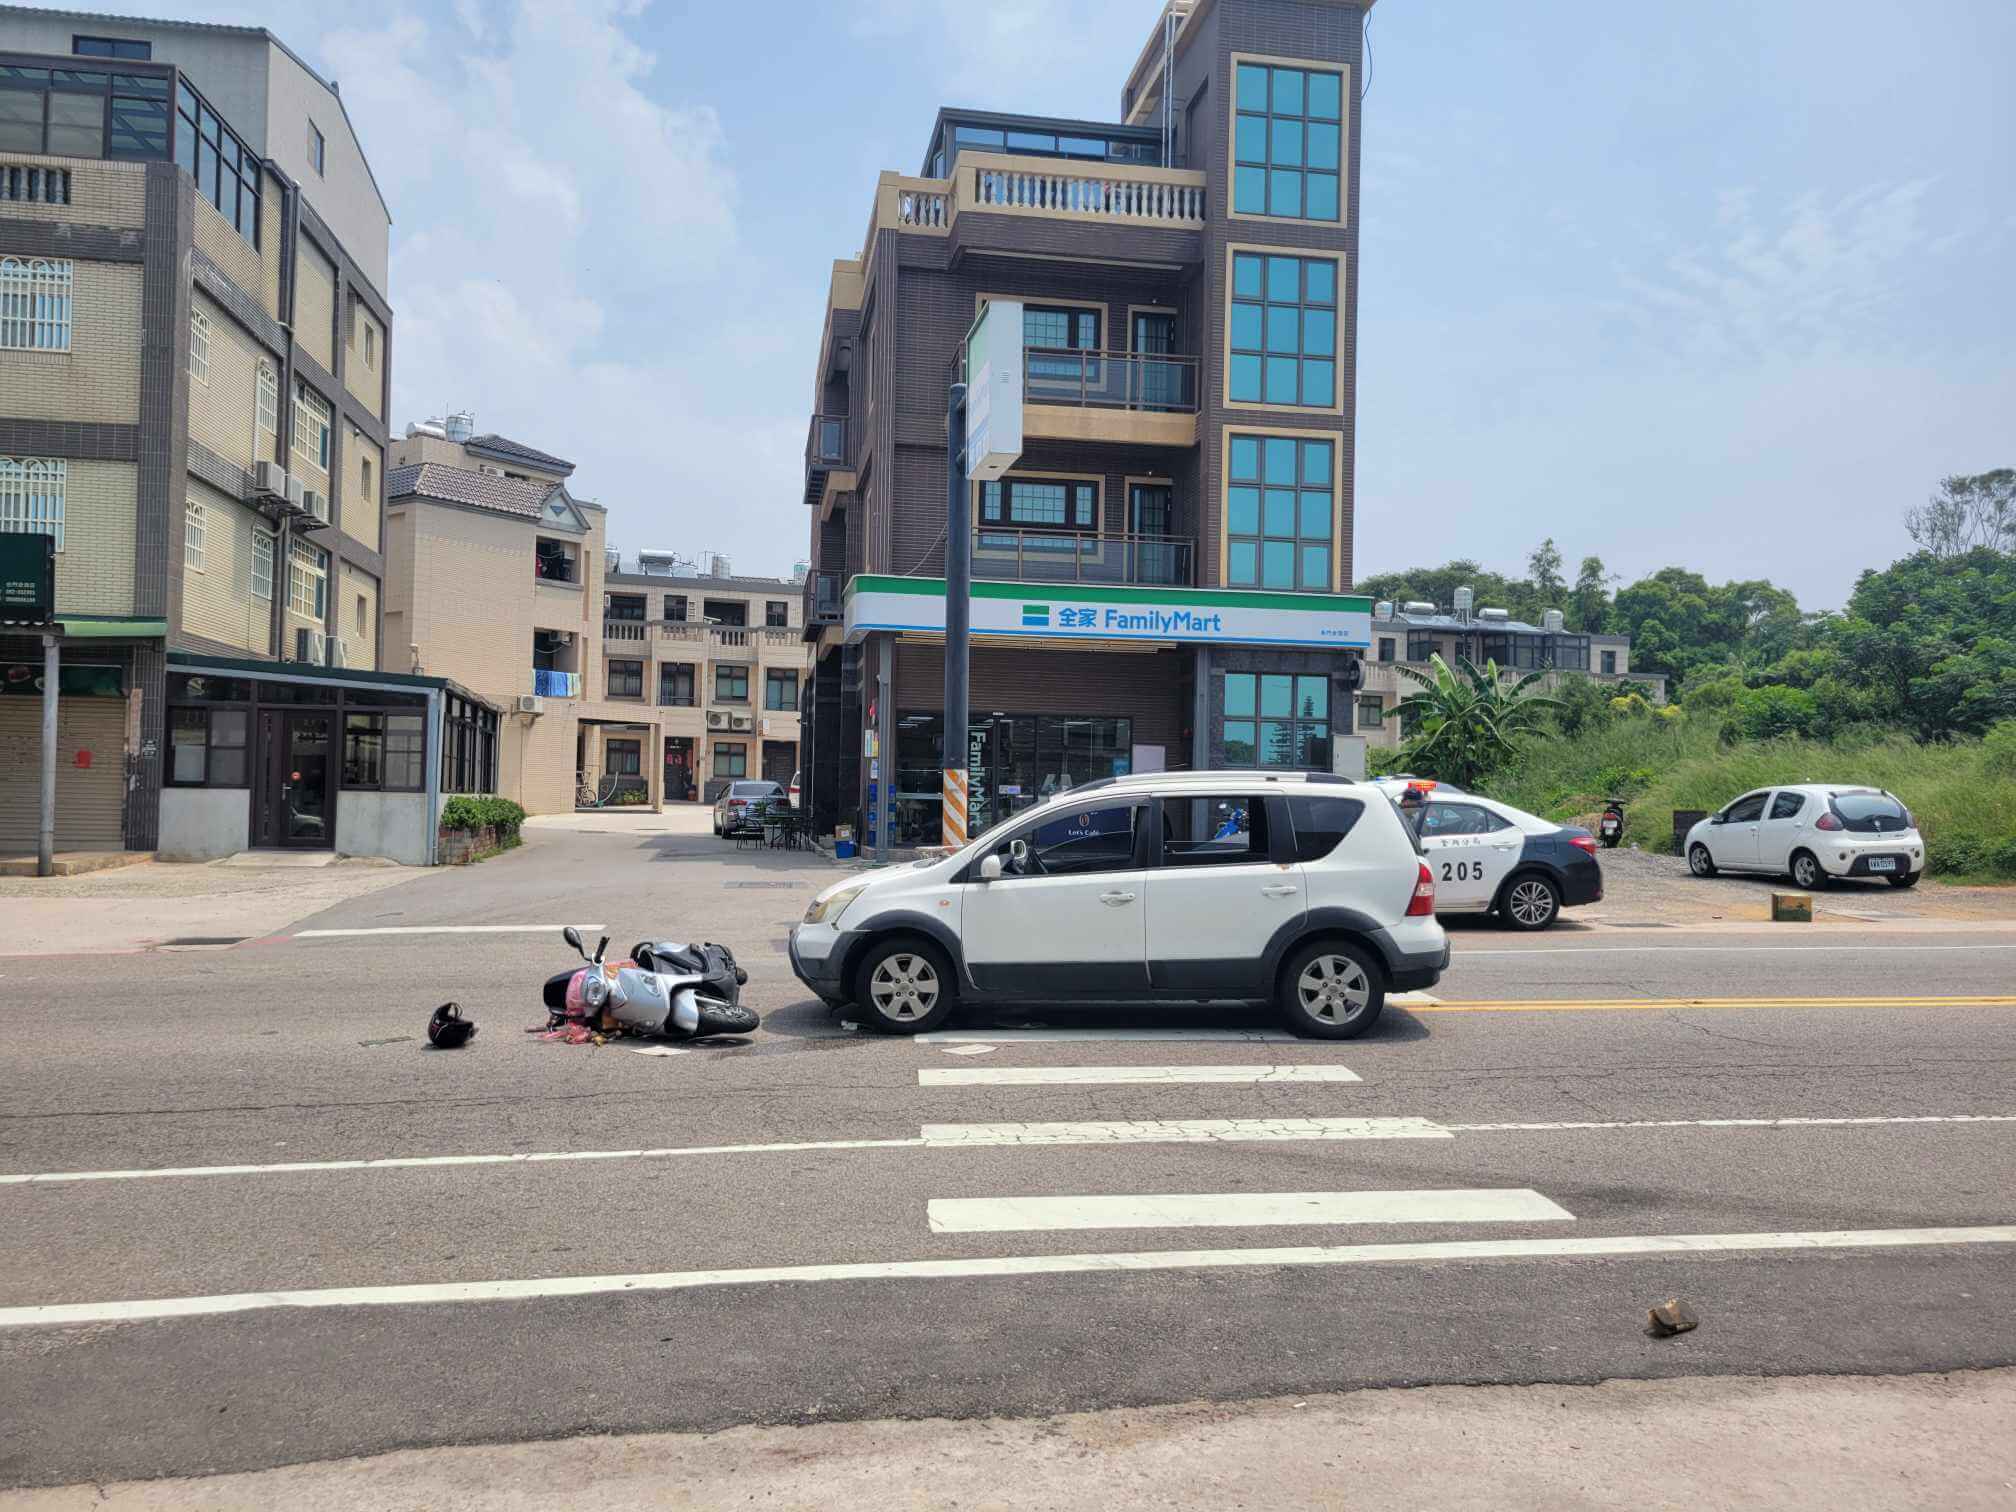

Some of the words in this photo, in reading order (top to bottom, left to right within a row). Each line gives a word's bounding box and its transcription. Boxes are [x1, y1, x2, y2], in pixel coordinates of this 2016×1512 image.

[1058, 607, 1097, 628] 全家
[1104, 609, 1221, 633] FamilyMart
[969, 732, 986, 827] FamilyMart
[1441, 861, 1483, 881] 205
